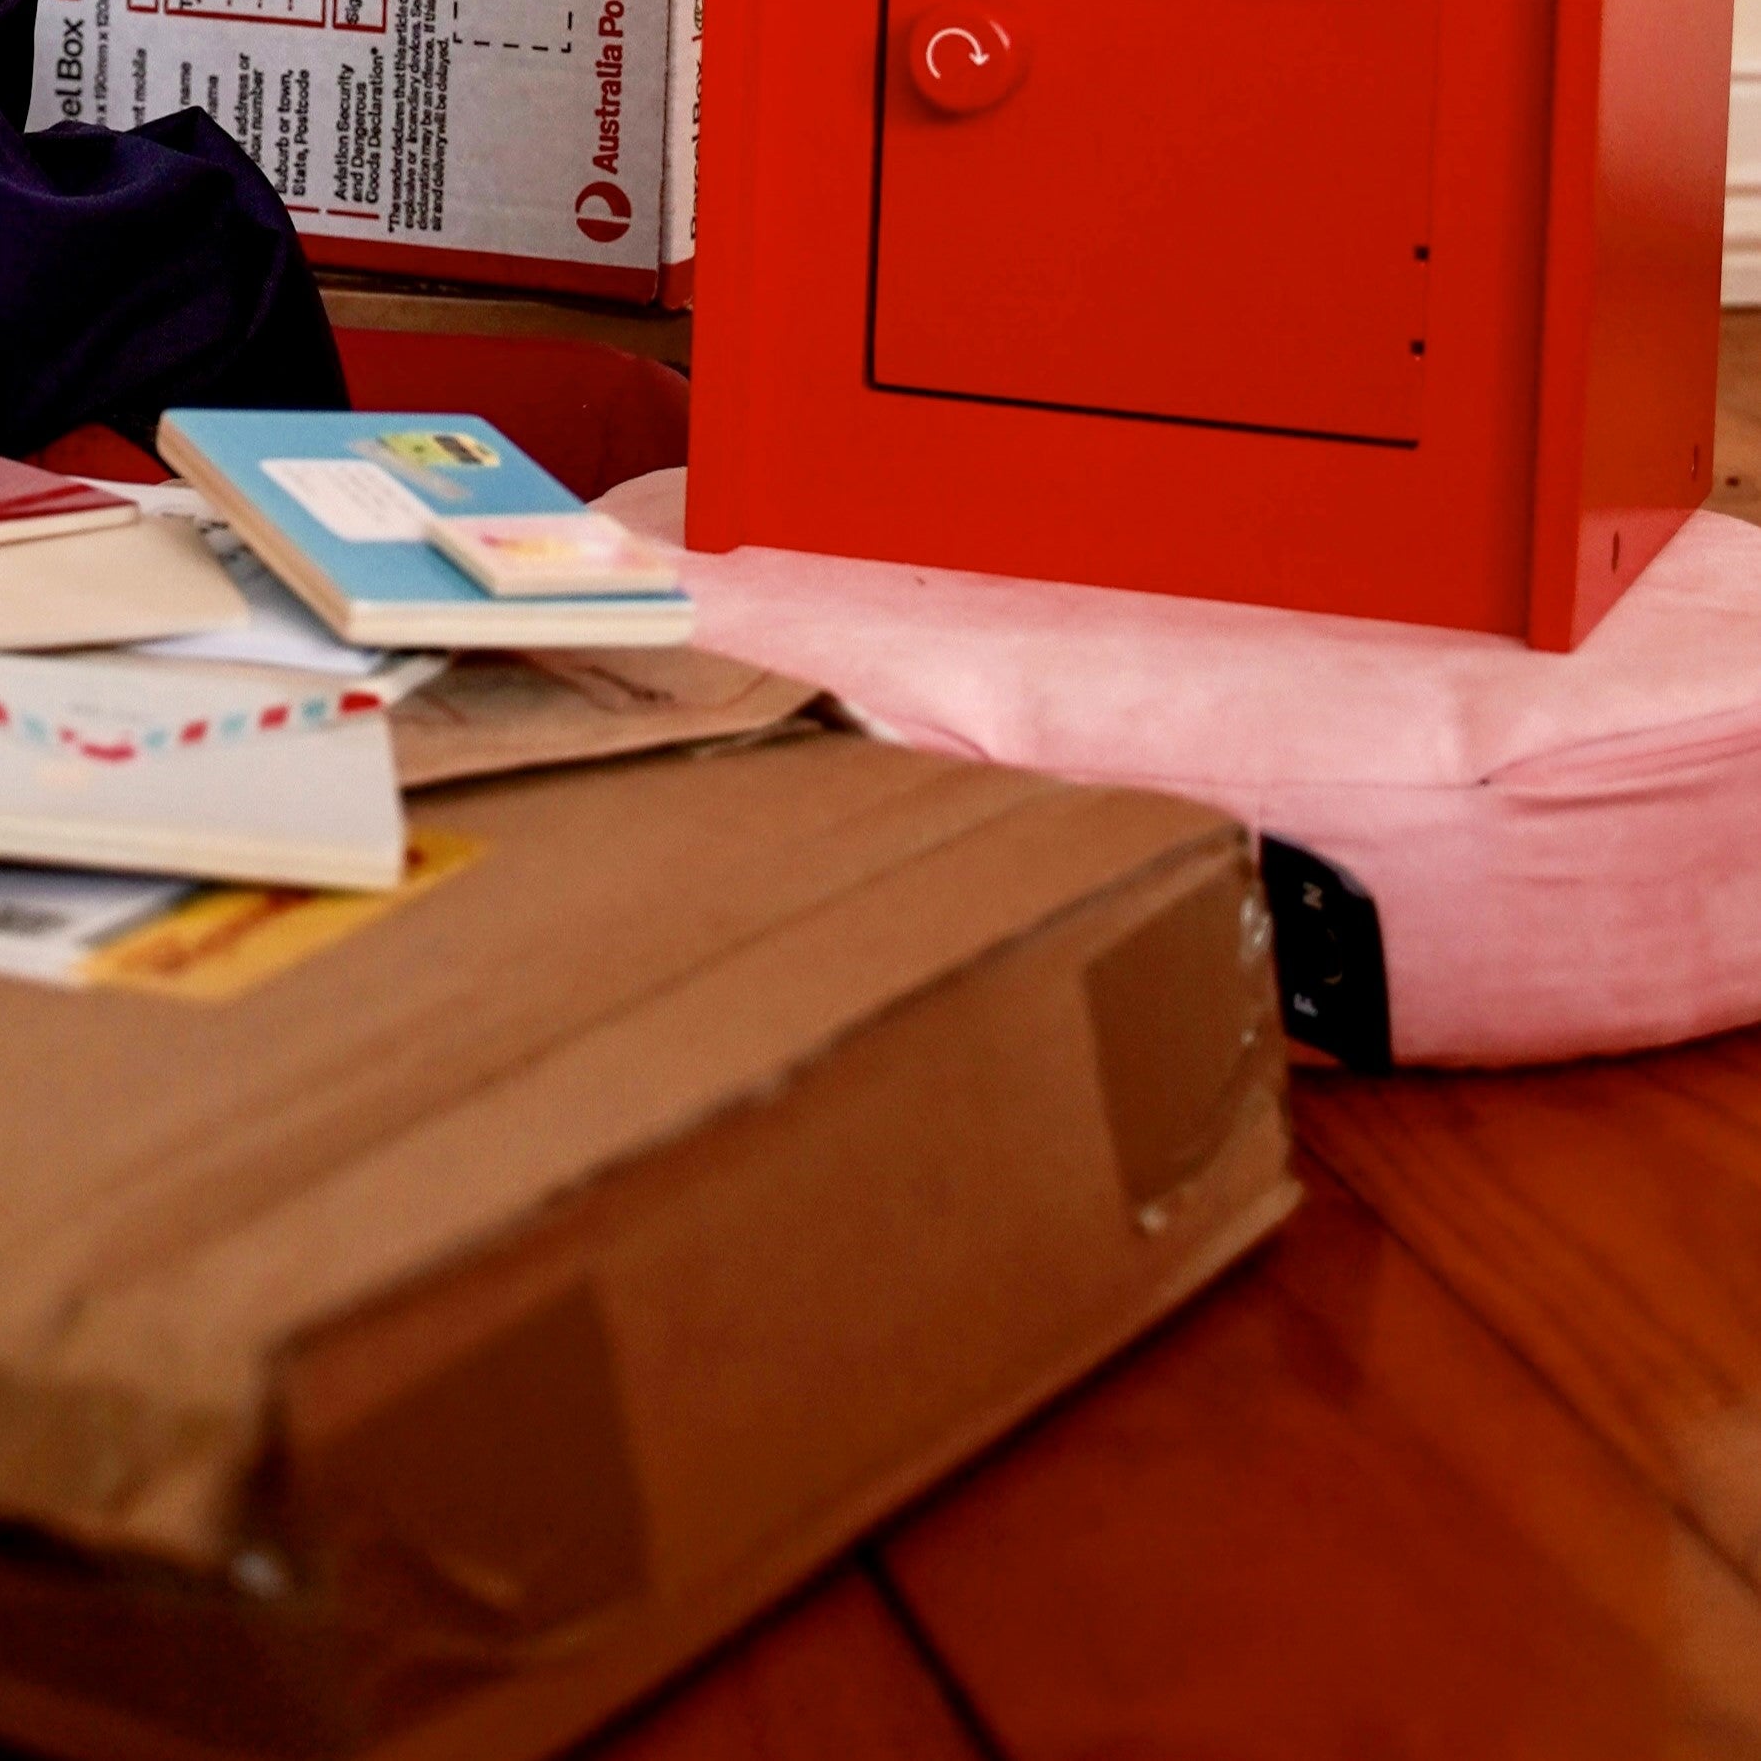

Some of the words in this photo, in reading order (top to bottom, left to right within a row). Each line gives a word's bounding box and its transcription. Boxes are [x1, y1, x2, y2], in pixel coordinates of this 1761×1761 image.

[55, 18, 85, 81] Box
[180, 61, 192, 106] name
[249, 69, 264, 131] number
[294, 69, 311, 145] Postcode
[336, 62, 355, 132] Security
[591, 45, 623, 176] Australia
[279, 117, 291, 134] or
[351, 81, 368, 169] Dangerous
[334, 135, 349, 202] Aviation
[349, 172, 364, 203] and
[365, 152, 380, 204] Goods
